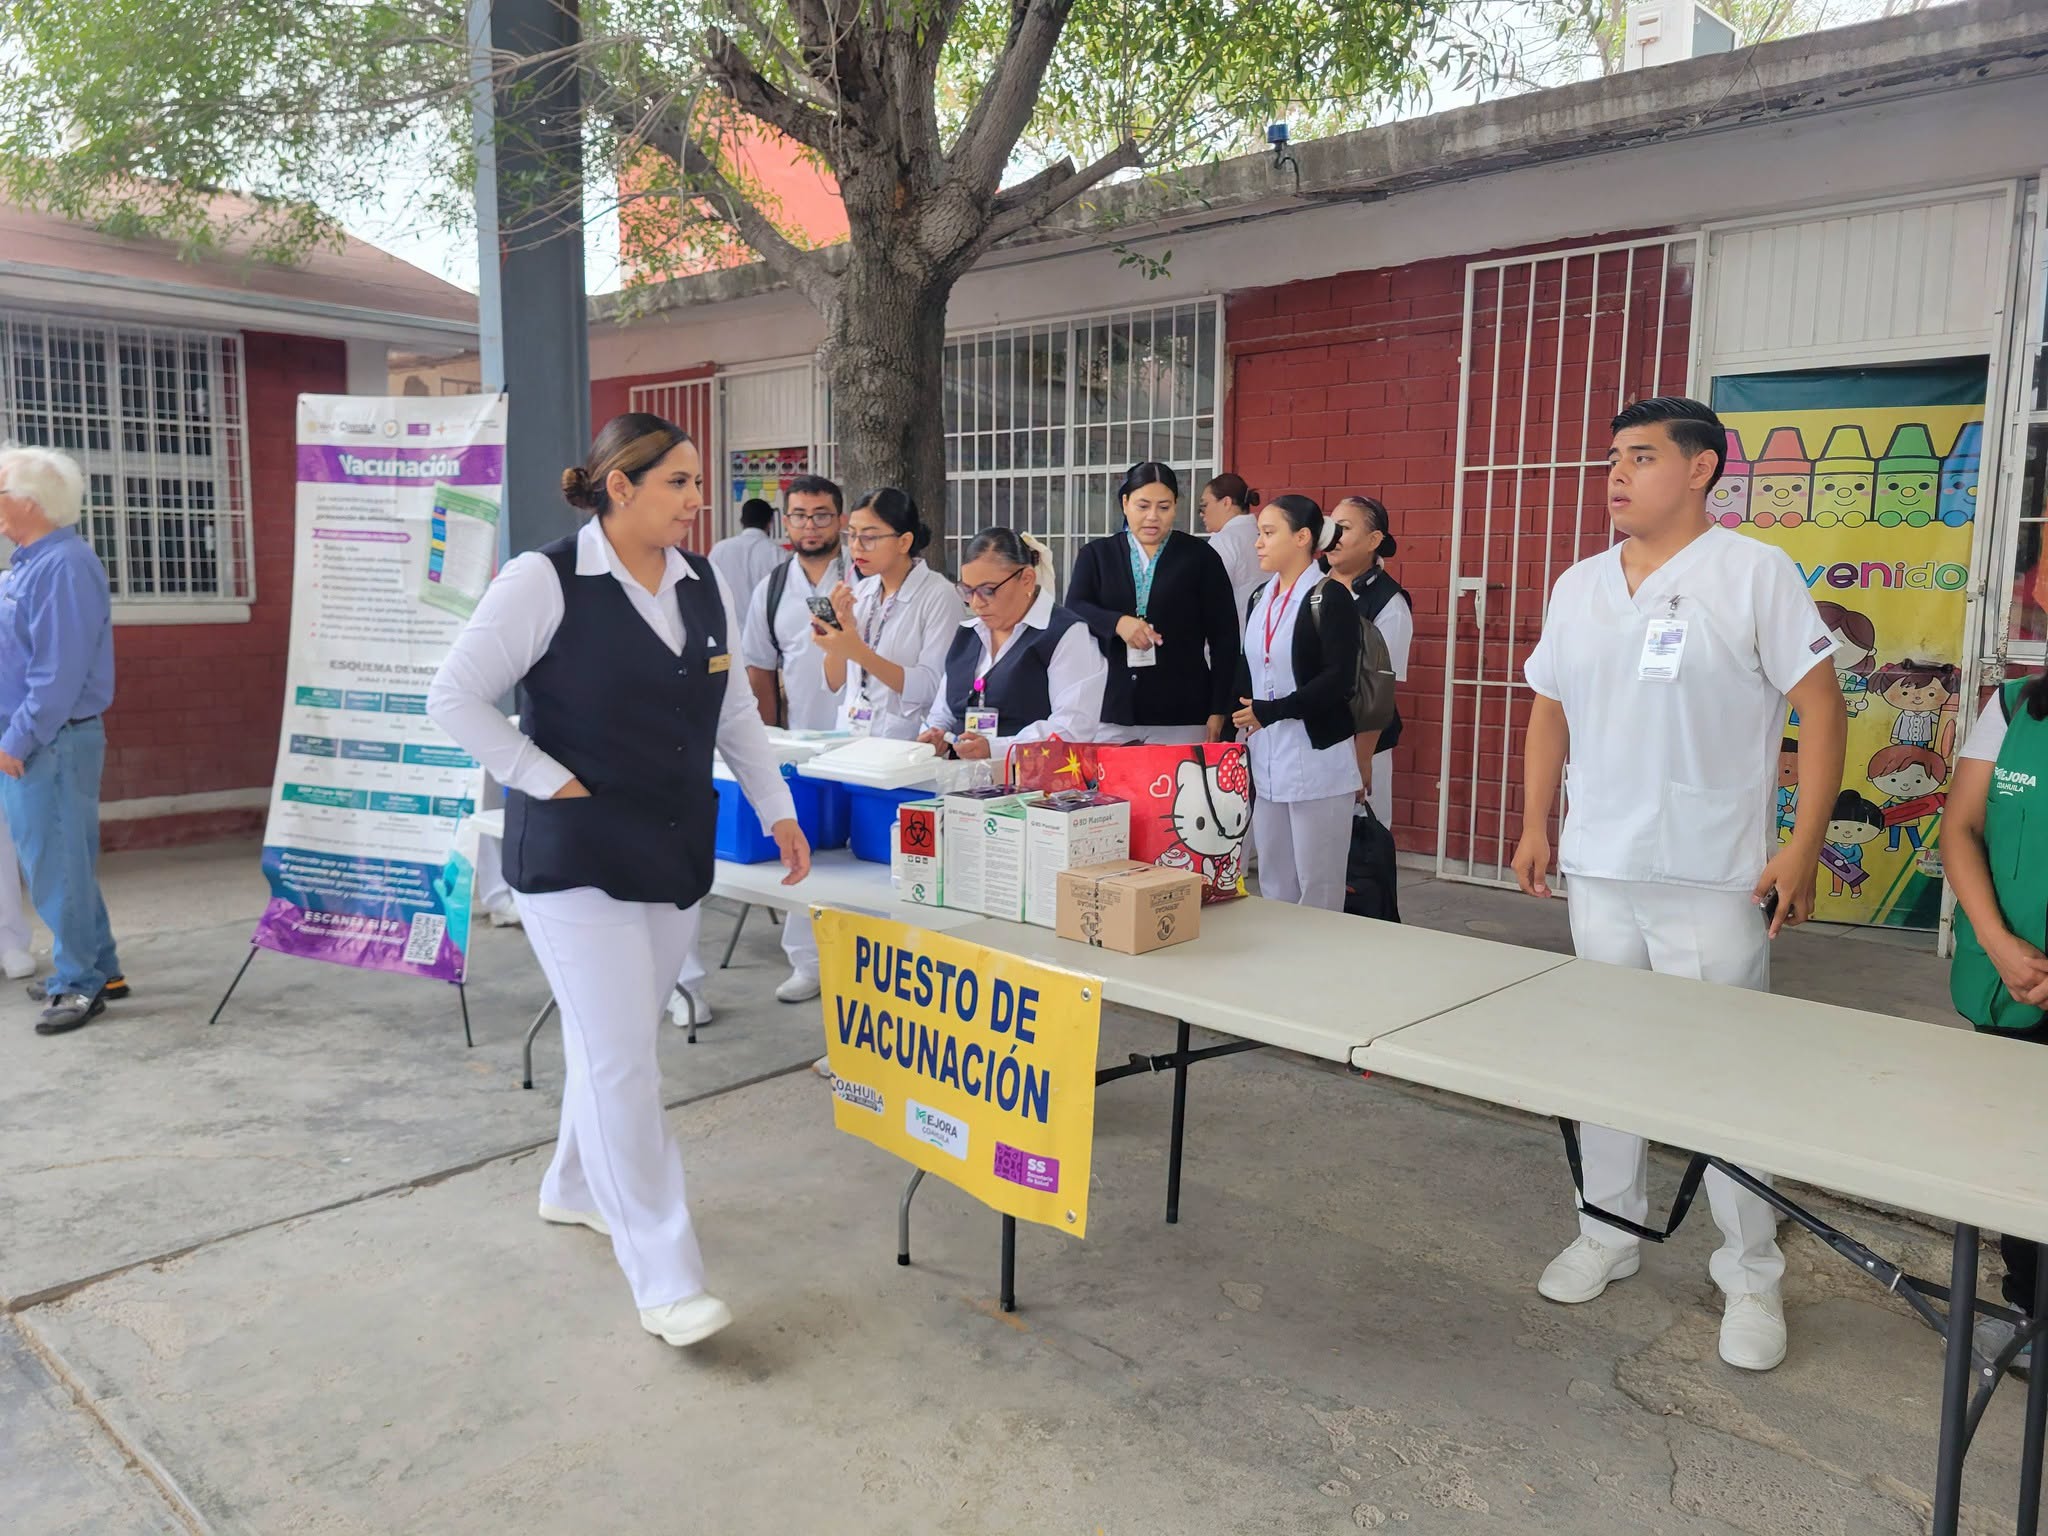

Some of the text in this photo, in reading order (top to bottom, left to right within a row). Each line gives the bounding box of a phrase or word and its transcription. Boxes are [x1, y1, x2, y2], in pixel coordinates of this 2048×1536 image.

[338, 453, 461, 477] Vacunación
[329, 659, 393, 674] ESQUEMA
[394, 664, 408, 674] DE
[1995, 766, 2036, 787] MEJORA
[1997, 781, 2024, 792] COAHUILA
[304, 911, 364, 929] ESCANEA
[855, 935, 1040, 1044] PUESTO DE
[836, 995, 1050, 1124] VACUNACIÓN
[915, 1106, 958, 1138] MEJORA
[1027, 1158, 1047, 1174] SS
